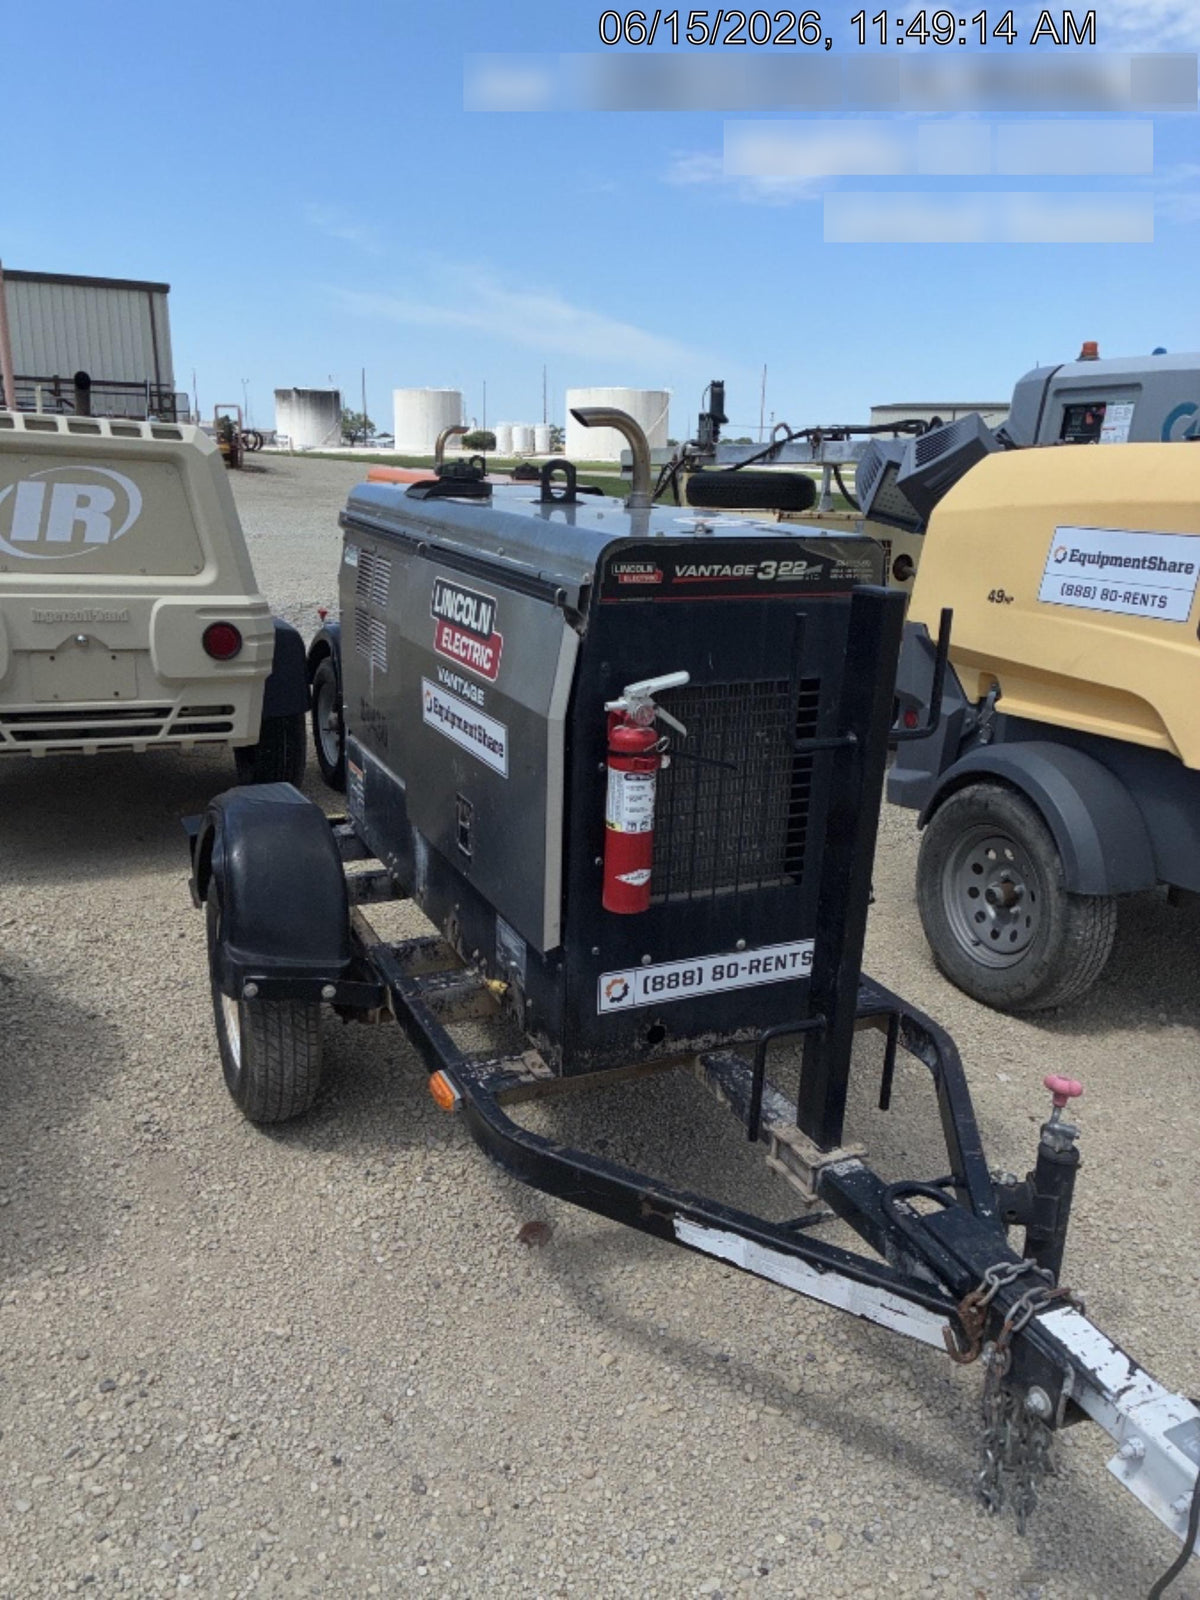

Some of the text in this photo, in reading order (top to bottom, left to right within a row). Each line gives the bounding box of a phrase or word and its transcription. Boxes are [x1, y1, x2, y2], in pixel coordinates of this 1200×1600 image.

[10, 481, 116, 544] IR
[614, 564, 654, 574] LINCOLN
[674, 564, 757, 577] VANTAGE
[756, 560, 808, 580] 322
[1068, 548, 1195, 575] EquipmentShare
[433, 584, 493, 636] LINCOLN
[1060, 582, 1168, 609] (888) 80-RENTS
[441, 626, 494, 670] ELECTRIC
[437, 665, 485, 706] VANTAGE
[433, 696, 504, 758] EquipmentShare
[642, 949, 814, 995] (888) 80-RENTS
